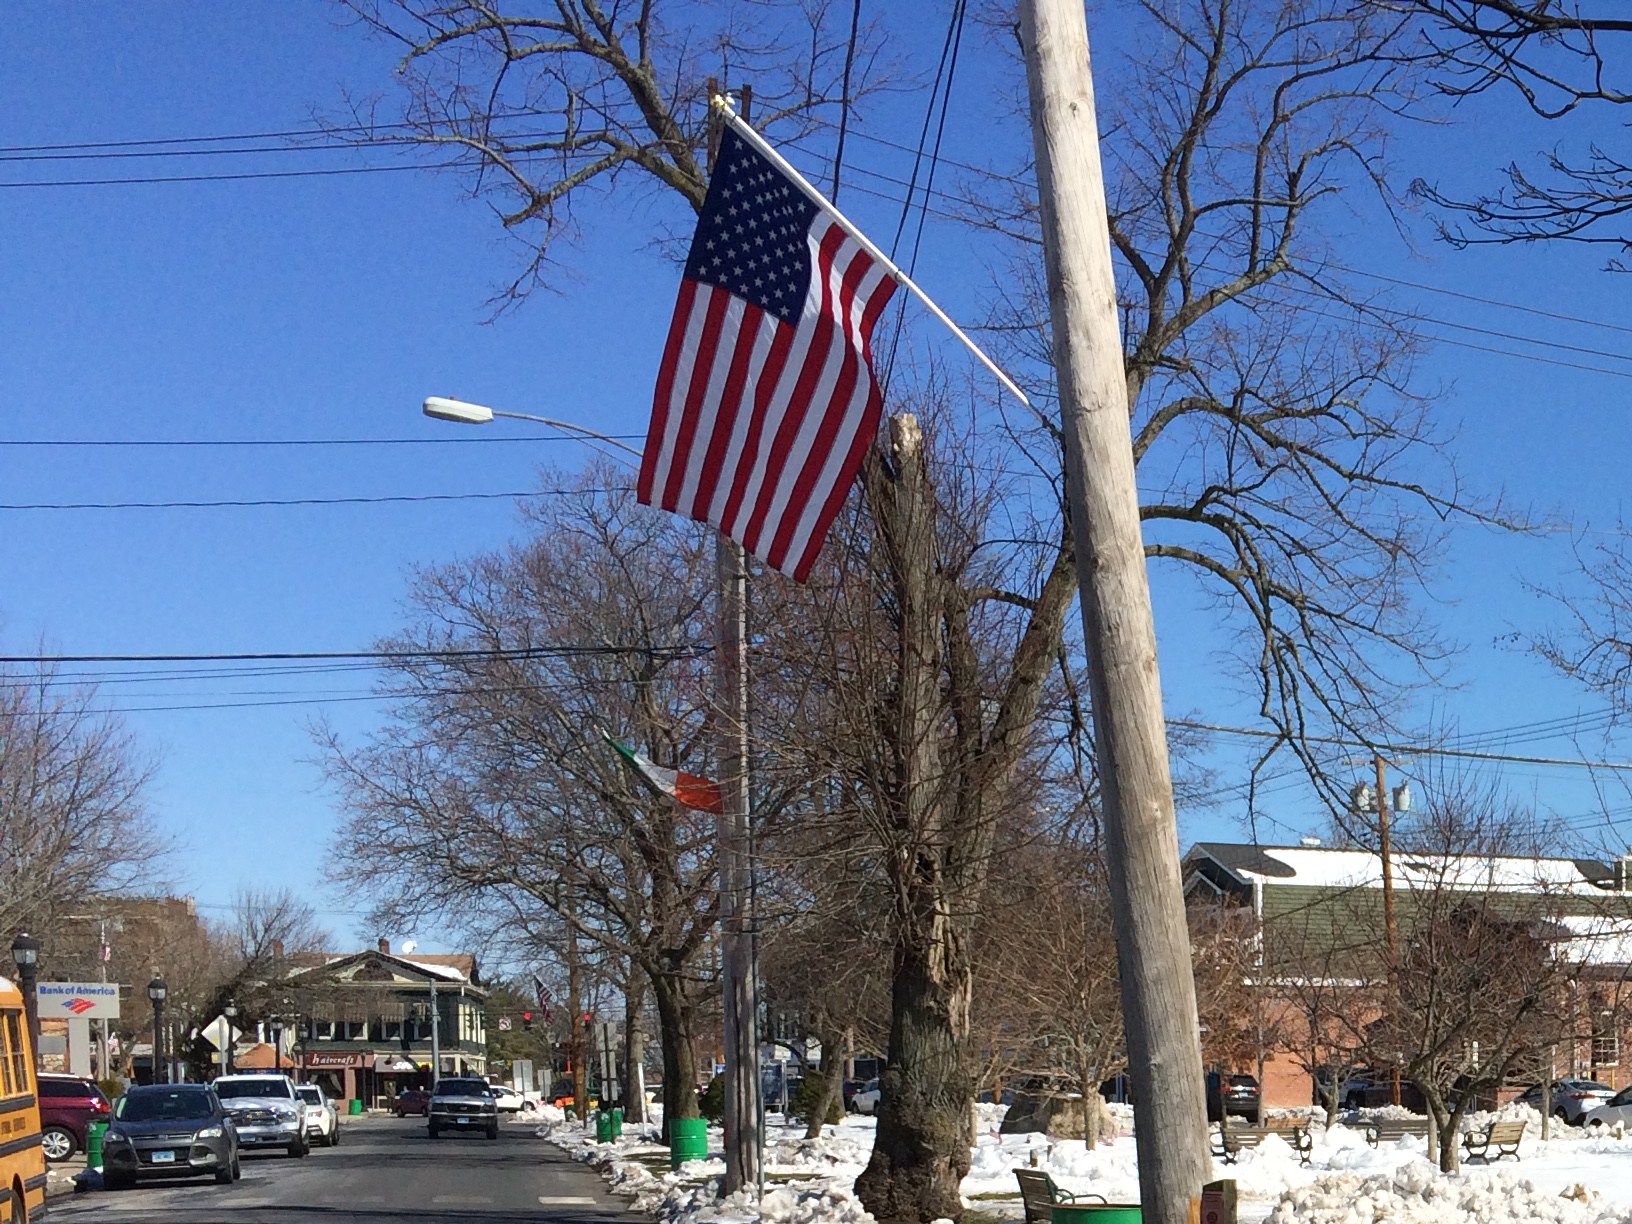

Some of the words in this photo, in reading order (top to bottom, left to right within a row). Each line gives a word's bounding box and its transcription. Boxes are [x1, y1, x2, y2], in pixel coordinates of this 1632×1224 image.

[39, 986, 64, 995] Bank
[65, 986, 75, 995] of
[76, 986, 116, 996] America
